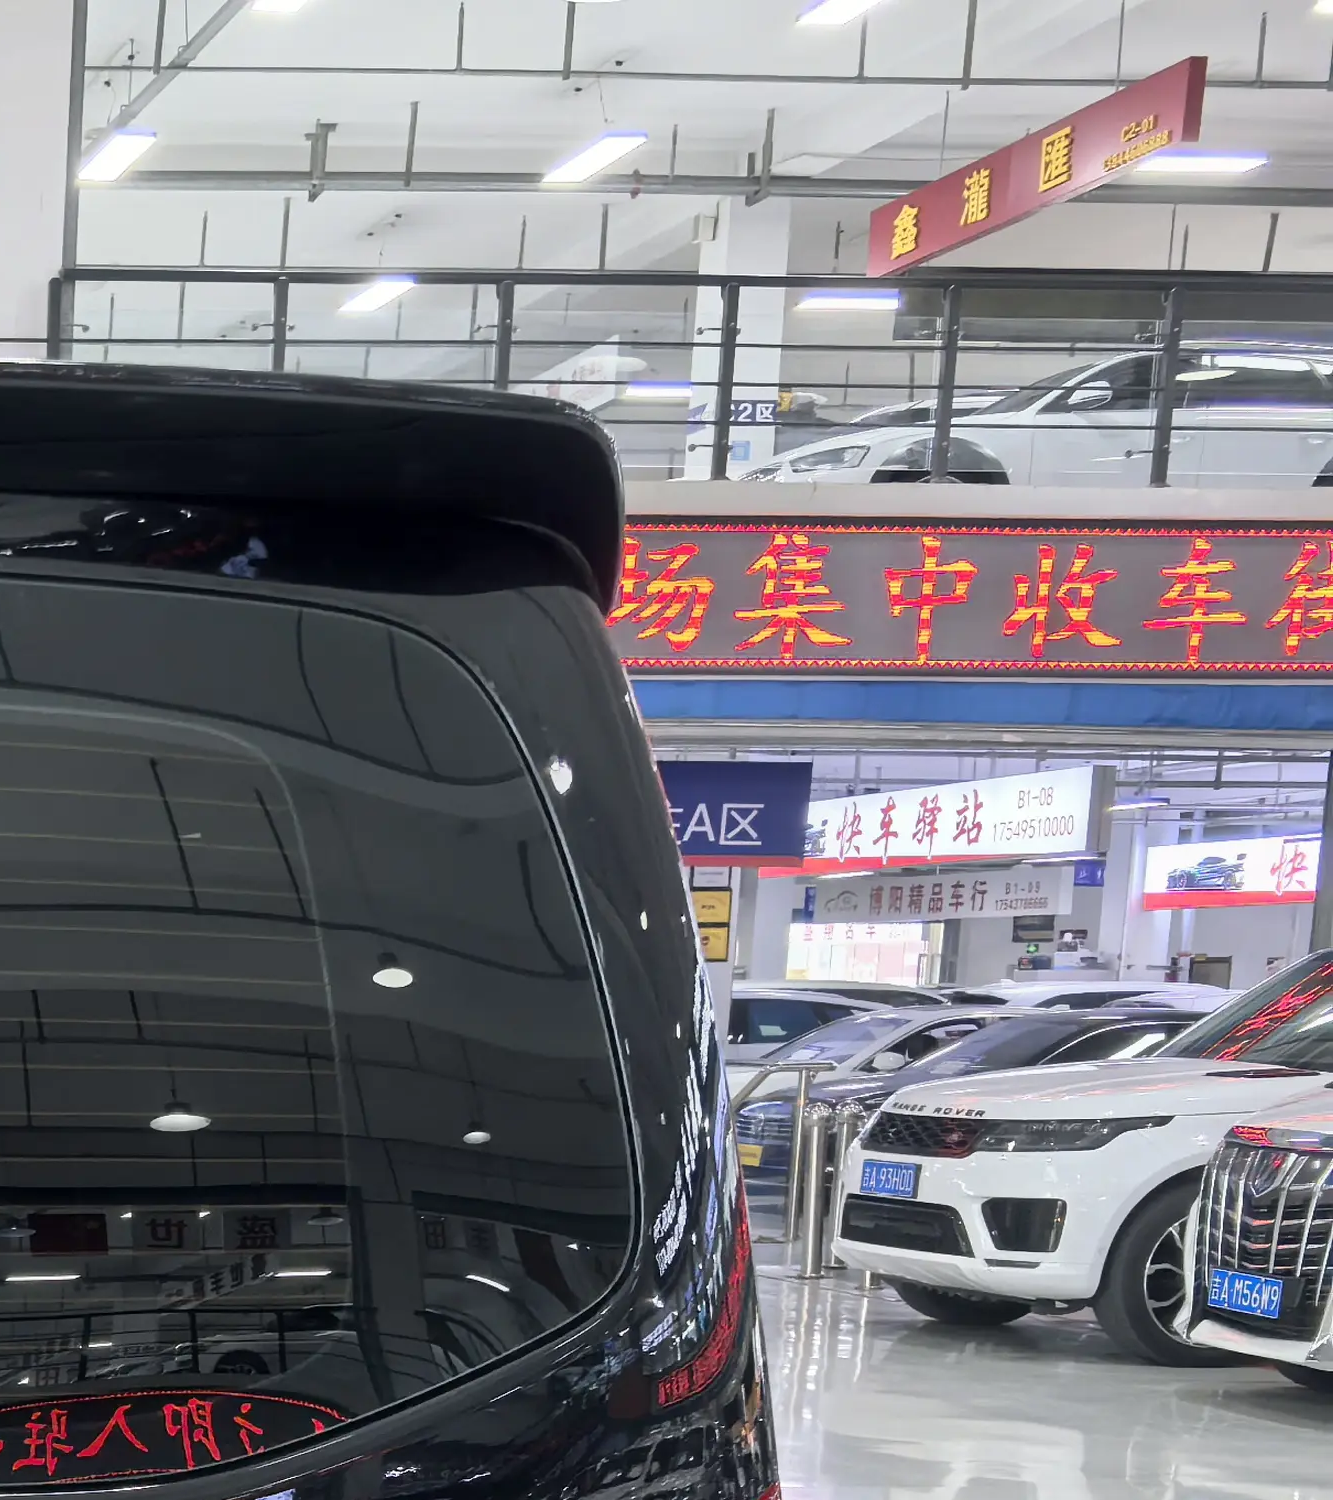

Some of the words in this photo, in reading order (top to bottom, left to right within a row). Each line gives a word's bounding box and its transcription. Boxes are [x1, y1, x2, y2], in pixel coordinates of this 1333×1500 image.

[730, 403, 776, 422] 2区
[1017, 787, 1054, 809] B1-08
[836, 789, 985, 863] 快车驿站
[1270, 844, 1308, 896] 快
[892, 1102, 927, 1112] RANGE
[933, 1107, 985, 1118] ROVER
